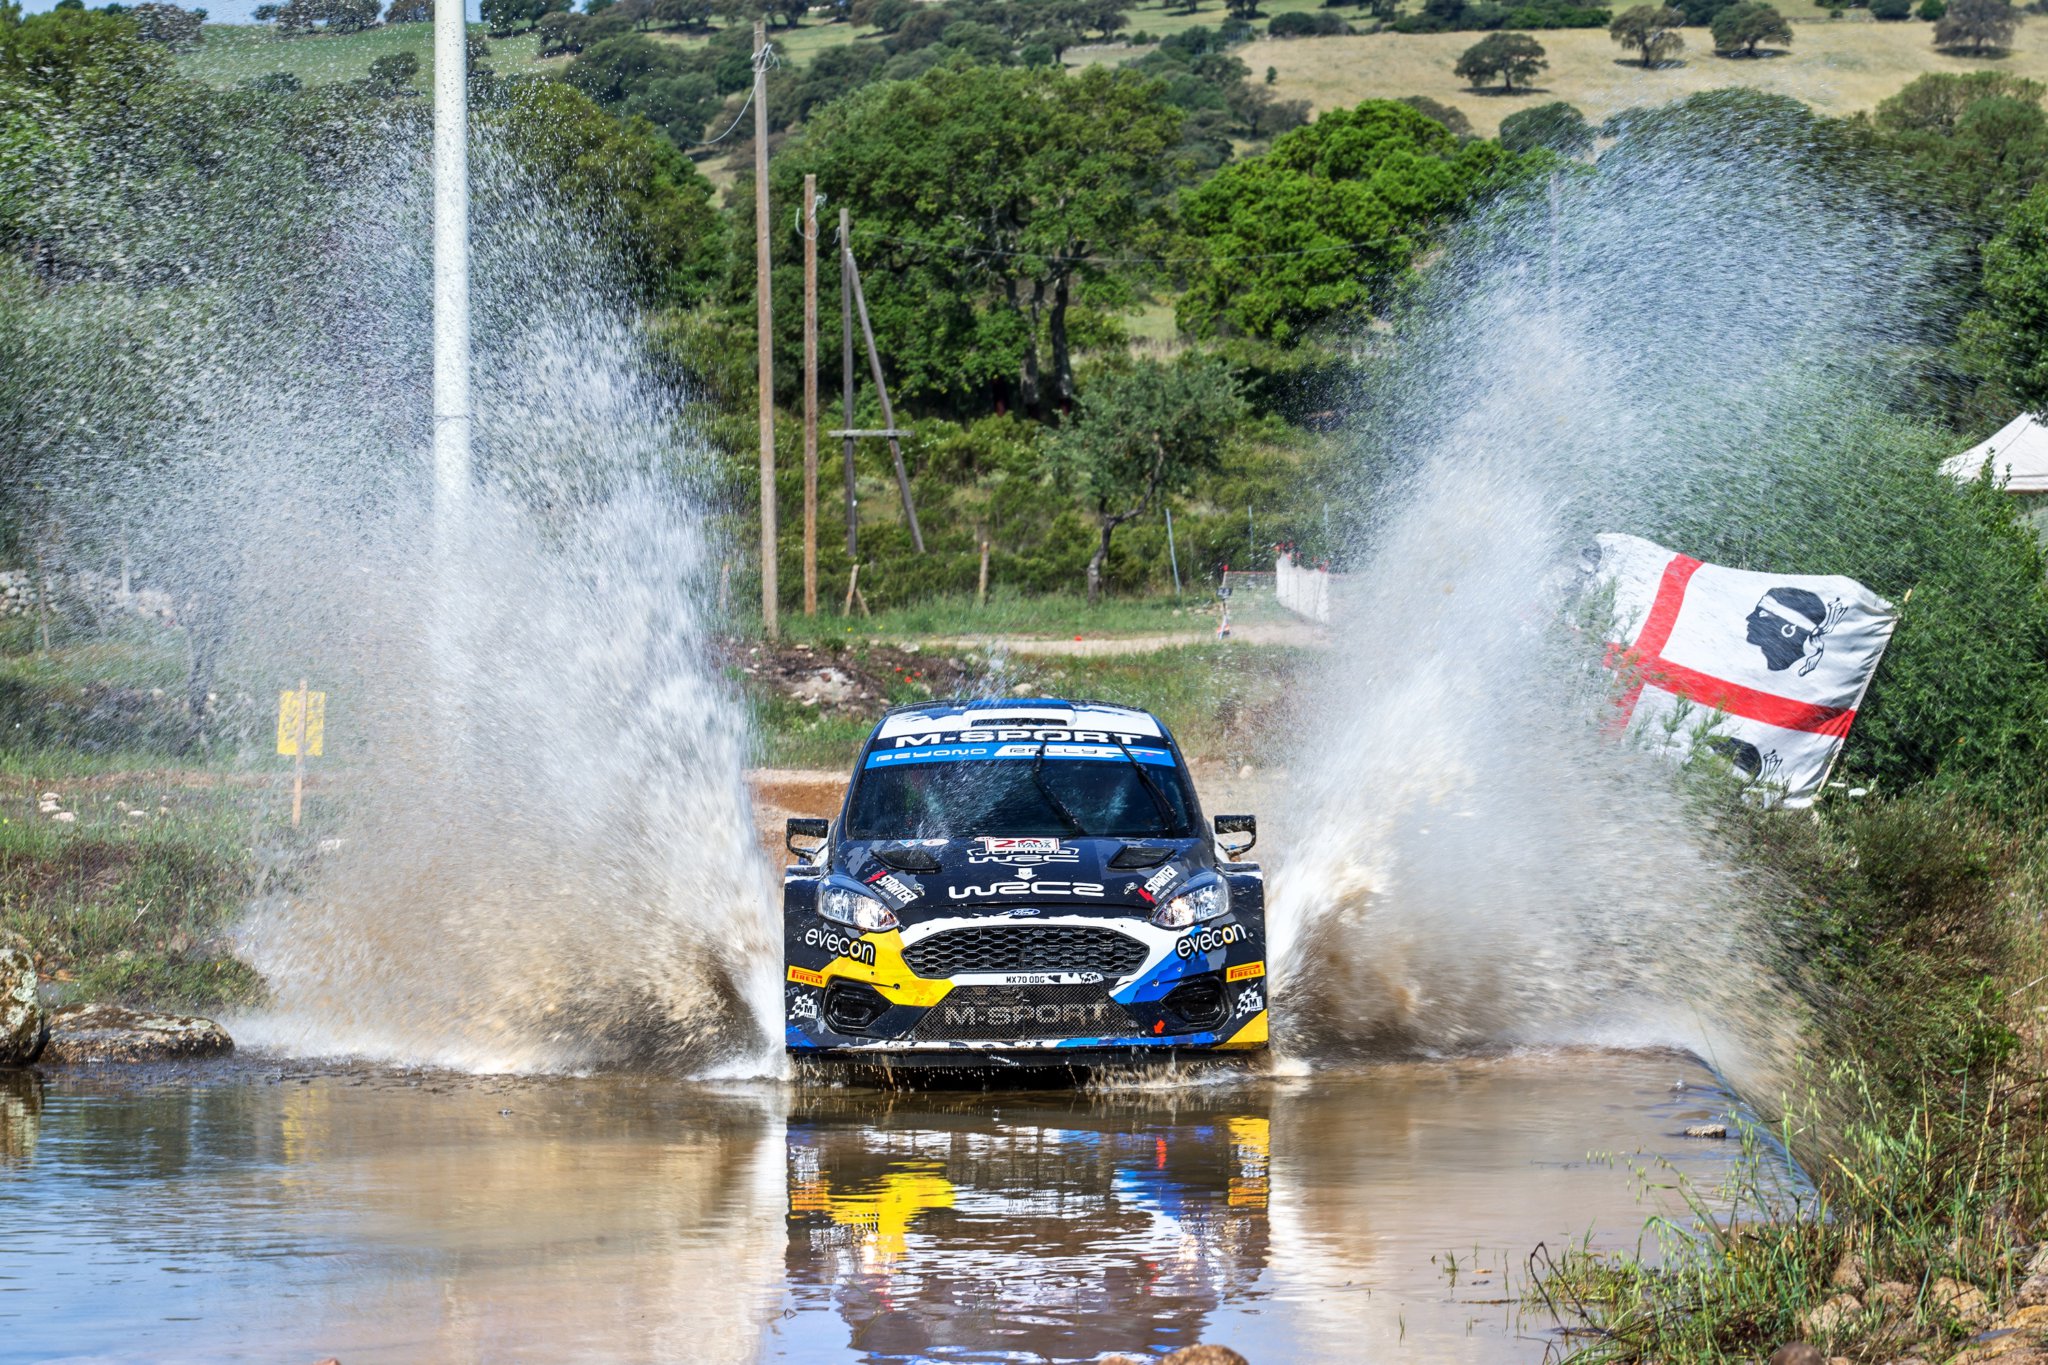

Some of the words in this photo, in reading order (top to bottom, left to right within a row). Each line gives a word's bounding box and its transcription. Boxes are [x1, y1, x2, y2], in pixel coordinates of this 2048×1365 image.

[895, 730, 1142, 748] M-SPORT
[876, 748, 987, 762] BEYOND
[968, 854, 1079, 864] WRC
[949, 881, 1105, 899] WRC2
[805, 928, 874, 964] evecon
[1177, 923, 1247, 957] evecon
[791, 969, 823, 985] PIRELLI
[1006, 976, 1028, 984] MX70
[1229, 964, 1261, 979] PIRELLI
[945, 1004, 1108, 1026] M-SPORT
